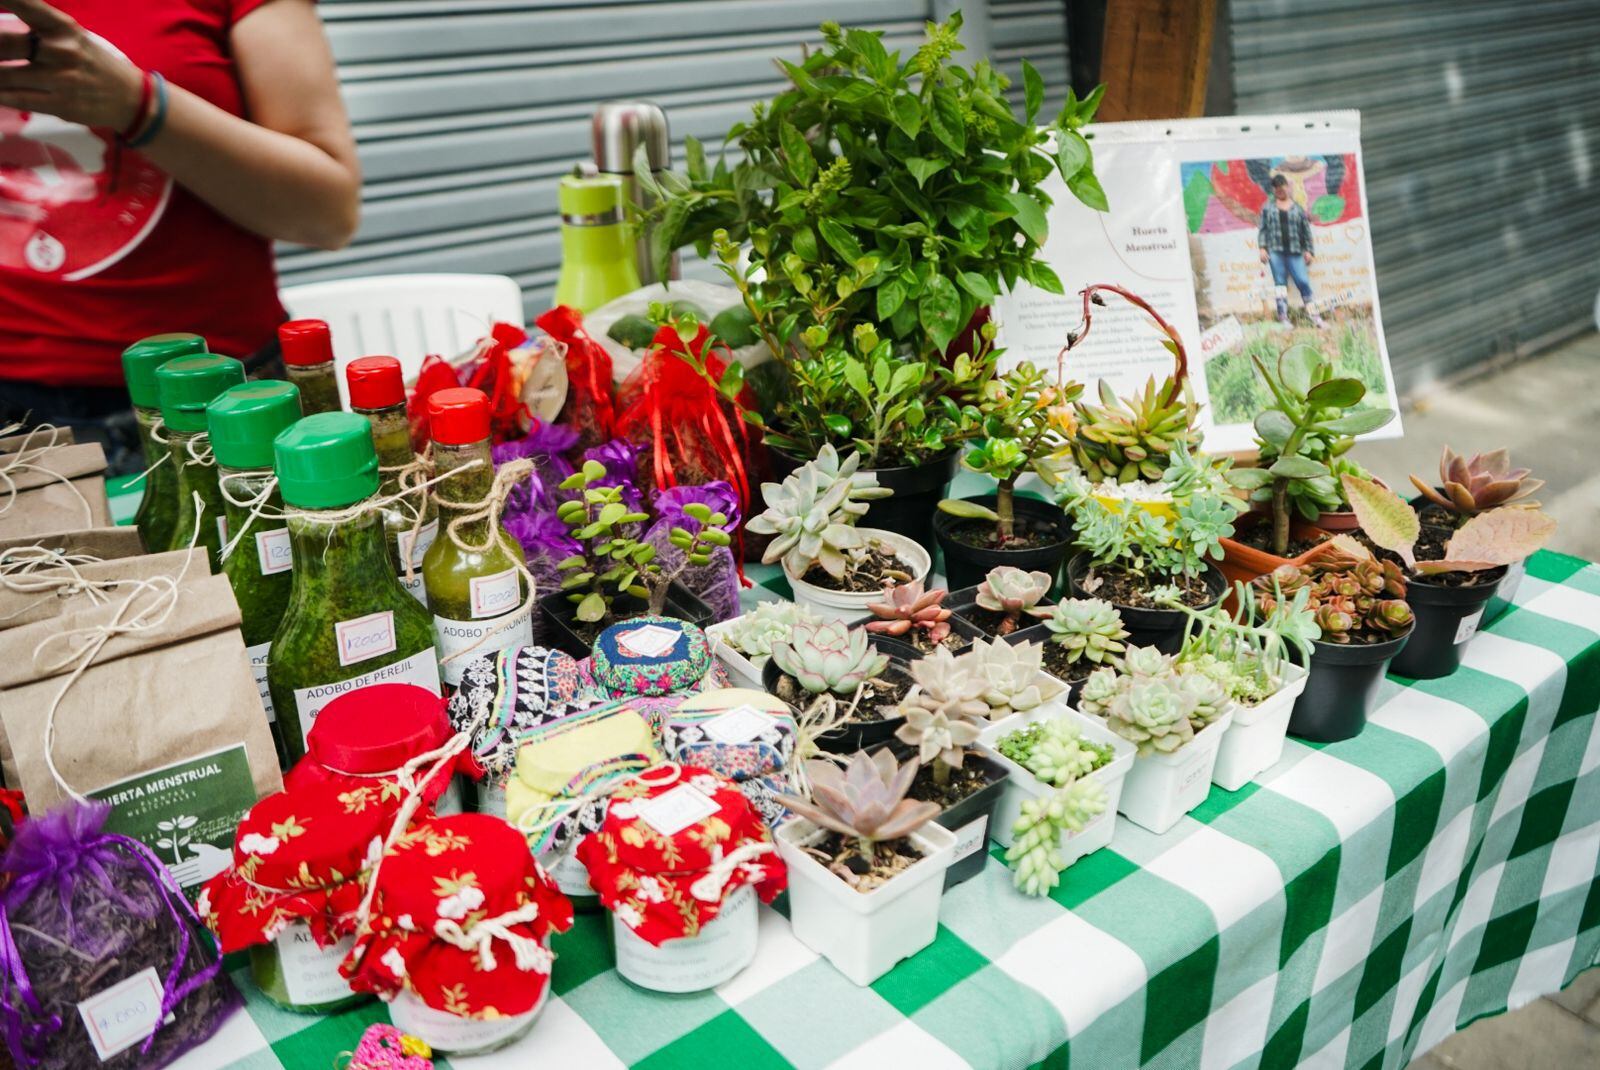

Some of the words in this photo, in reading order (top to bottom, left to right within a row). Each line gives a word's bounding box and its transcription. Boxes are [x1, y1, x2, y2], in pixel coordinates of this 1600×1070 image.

[1132, 226, 1168, 236] Huerta
[1126, 239, 1176, 252] Menstrual
[483, 586, 517, 605] 12000
[347, 628, 392, 651] 12000
[443, 626, 482, 638] ADOBO
[306, 681, 352, 700] ADOBO
[355, 675, 371, 689] DE
[373, 661, 414, 683] PEREJIL
[145, 763, 222, 795] MENSTRUAL
[127, 790, 197, 817] MEDICINALES
